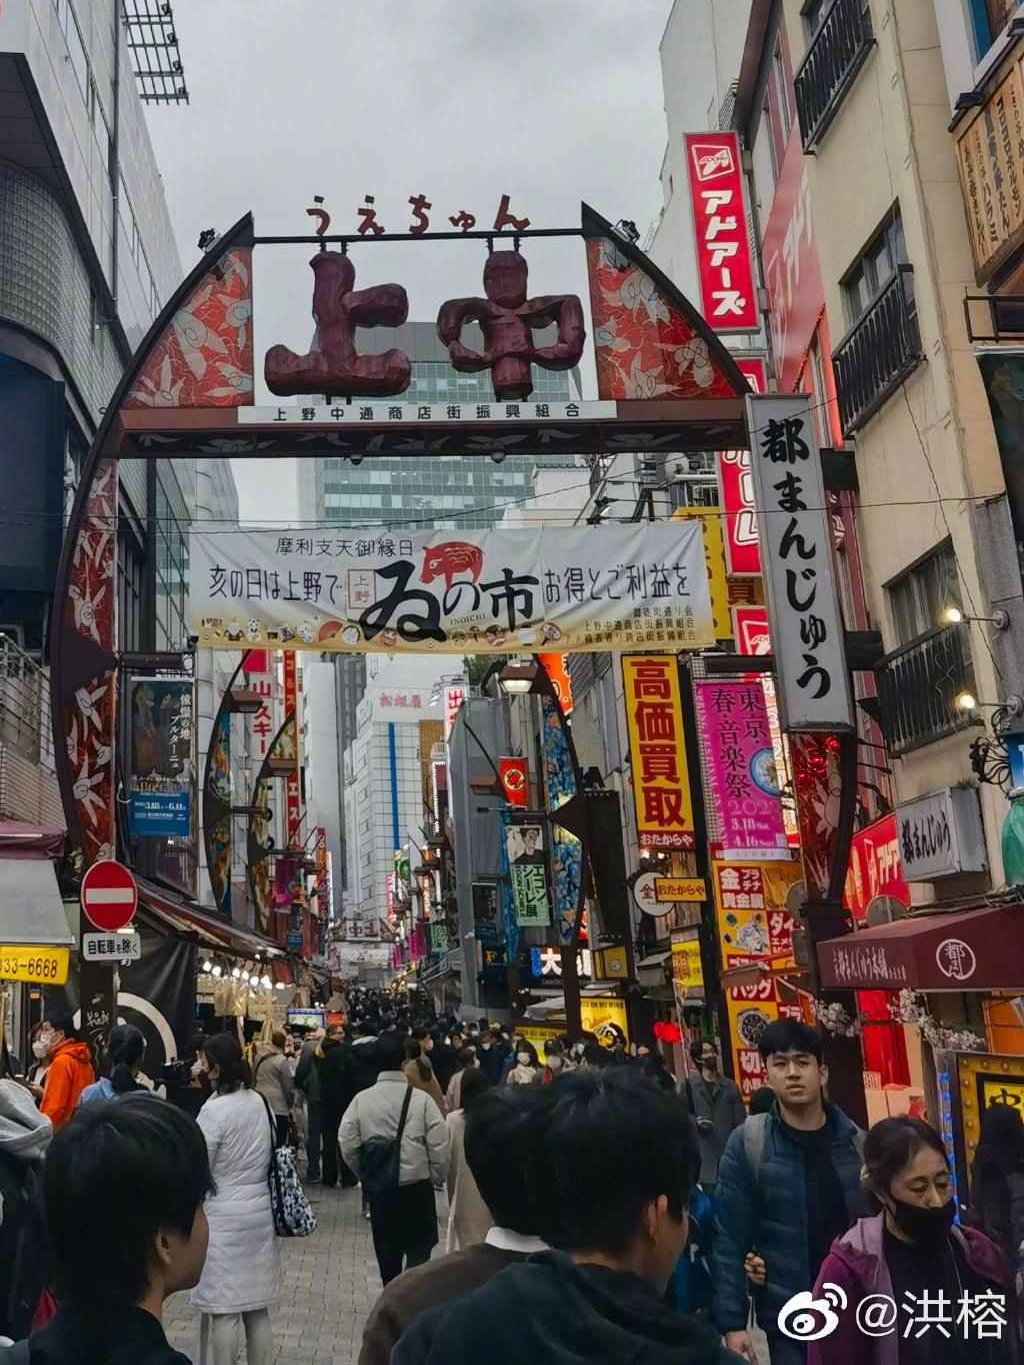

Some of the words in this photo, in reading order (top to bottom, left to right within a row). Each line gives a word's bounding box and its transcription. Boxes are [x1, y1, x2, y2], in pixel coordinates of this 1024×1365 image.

[306, 194, 531, 236] うえちゅん
[700, 190, 746, 316] アドアーズ
[273, 403, 581, 423] 上野中通商店街振興組合
[275, 537, 413, 558] 摩利支天御縁日
[762, 417, 832, 700] 都まんじゅう
[209, 566, 342, 605] 亥の日は上野で
[354, 574, 371, 603] 上野
[543, 563, 693, 604] お得とご利益を
[450, 613, 486, 625] INOICHI
[631, 659, 686, 827] 高価買取
[640, 833, 693, 846] おたからや
[902, 811, 951, 864] 都まんじゅう
[657, 884, 705, 896] おたからや
[719, 867, 741, 890] 金
[88, 938, 138, 954] 自転車を除く
